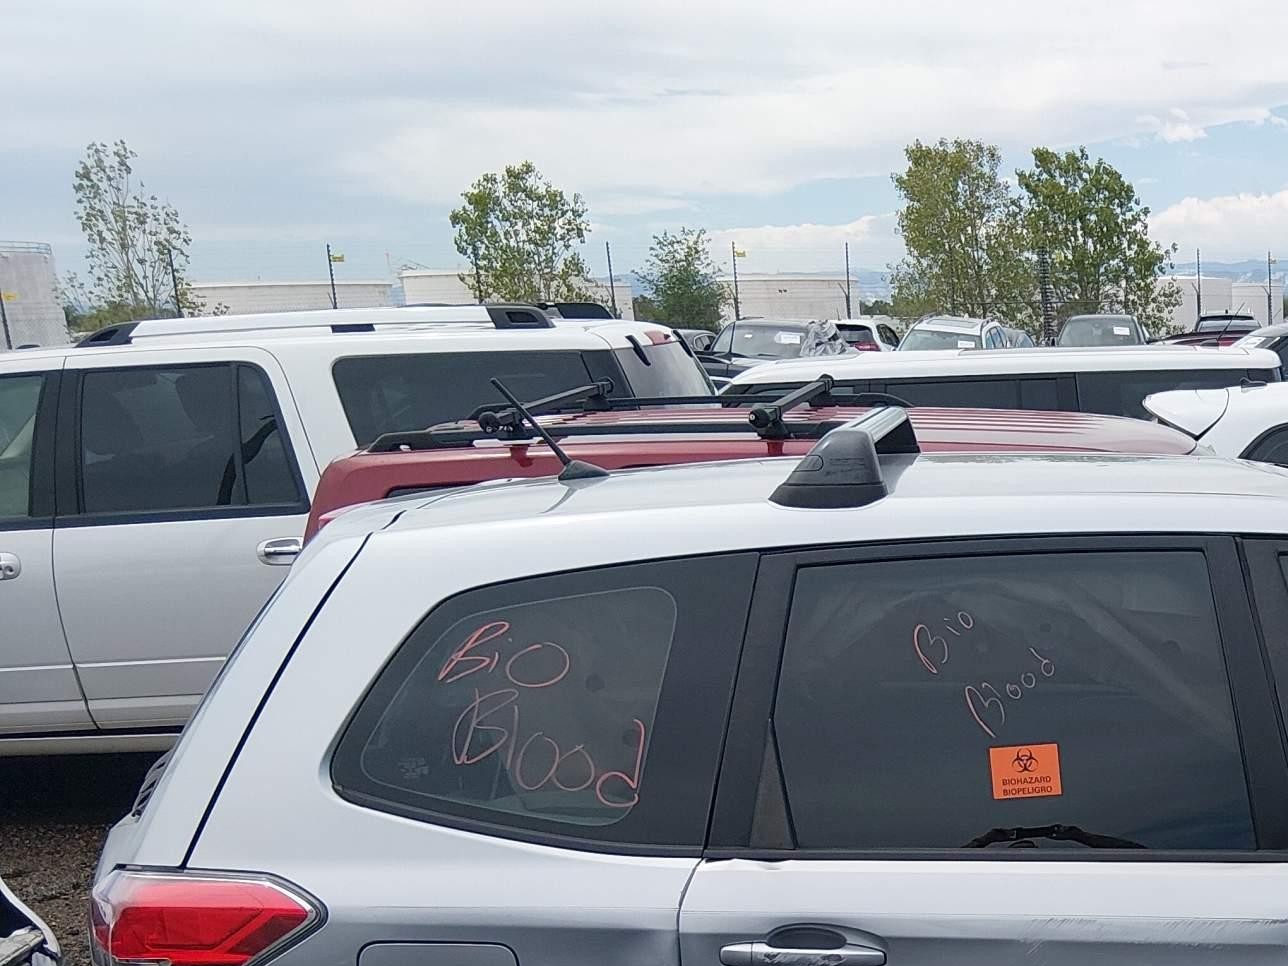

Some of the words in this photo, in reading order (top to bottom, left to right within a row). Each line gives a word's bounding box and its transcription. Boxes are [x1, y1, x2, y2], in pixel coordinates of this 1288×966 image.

[965, 647, 1055, 739] Blood
[452, 687, 645, 808] Blood
[1001, 775, 1052, 787] BIOHAZARD
[1002, 785, 1053, 797] BIOPELIGRO
